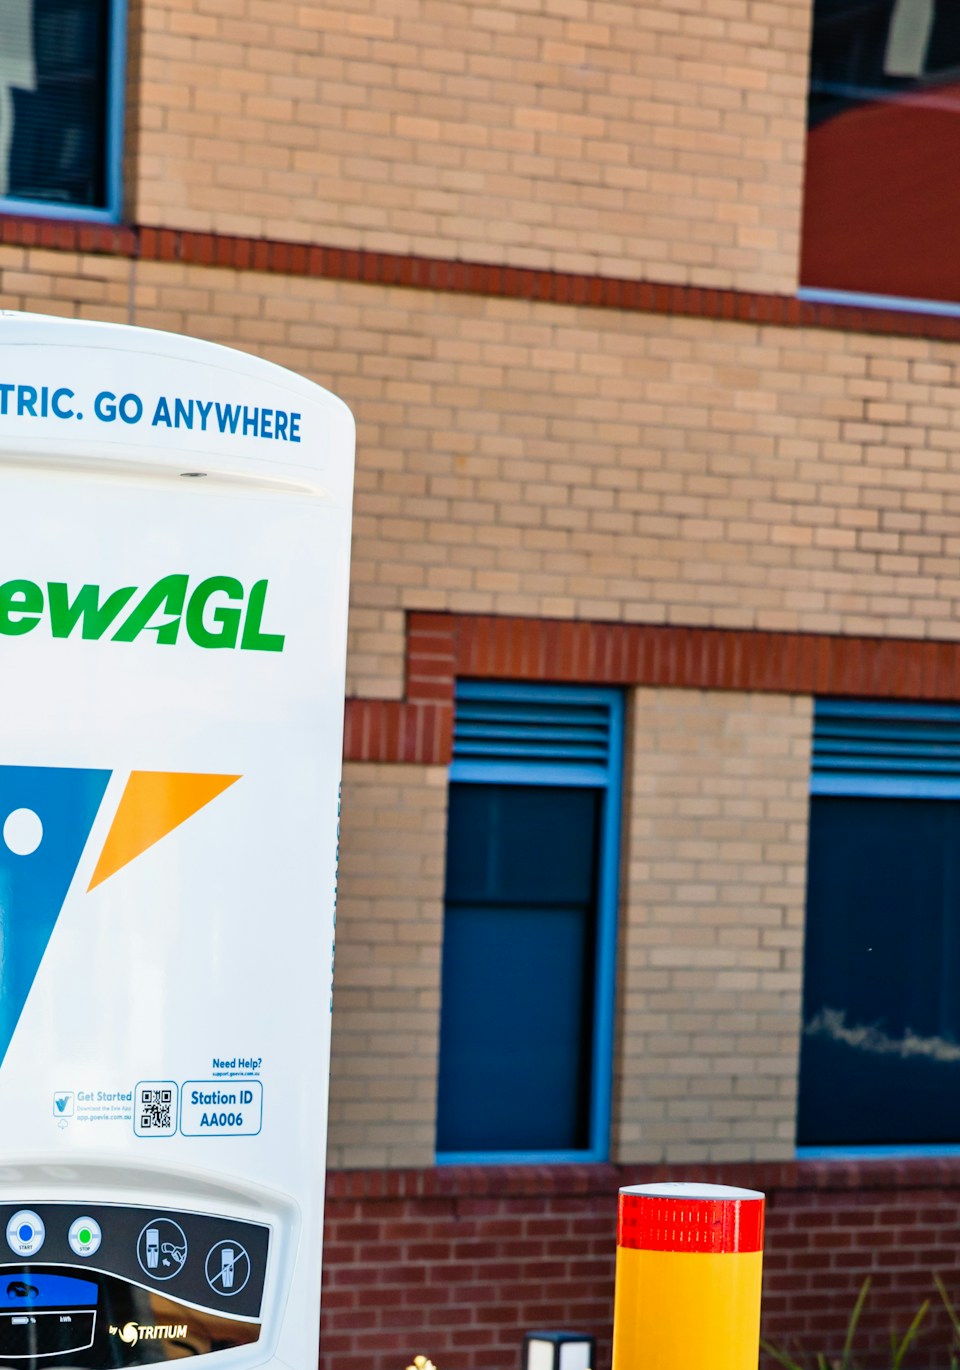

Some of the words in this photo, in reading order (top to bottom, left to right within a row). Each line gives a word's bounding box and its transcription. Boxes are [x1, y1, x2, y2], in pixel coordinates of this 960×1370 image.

[94, 391, 143, 425] GO
[151, 397, 302, 443] ANYWHERE
[212, 1058, 236, 1069] Need
[238, 1057, 263, 1071] Help?
[77, 1091, 94, 1102] Get
[97, 1091, 132, 1101] Started
[191, 1090, 237, 1106] Station
[239, 1090, 253, 1105] ID
[200, 1112, 244, 1127] AA006
[108, 1324, 118, 1336] by
[137, 1324, 188, 1340] TRITIUM
